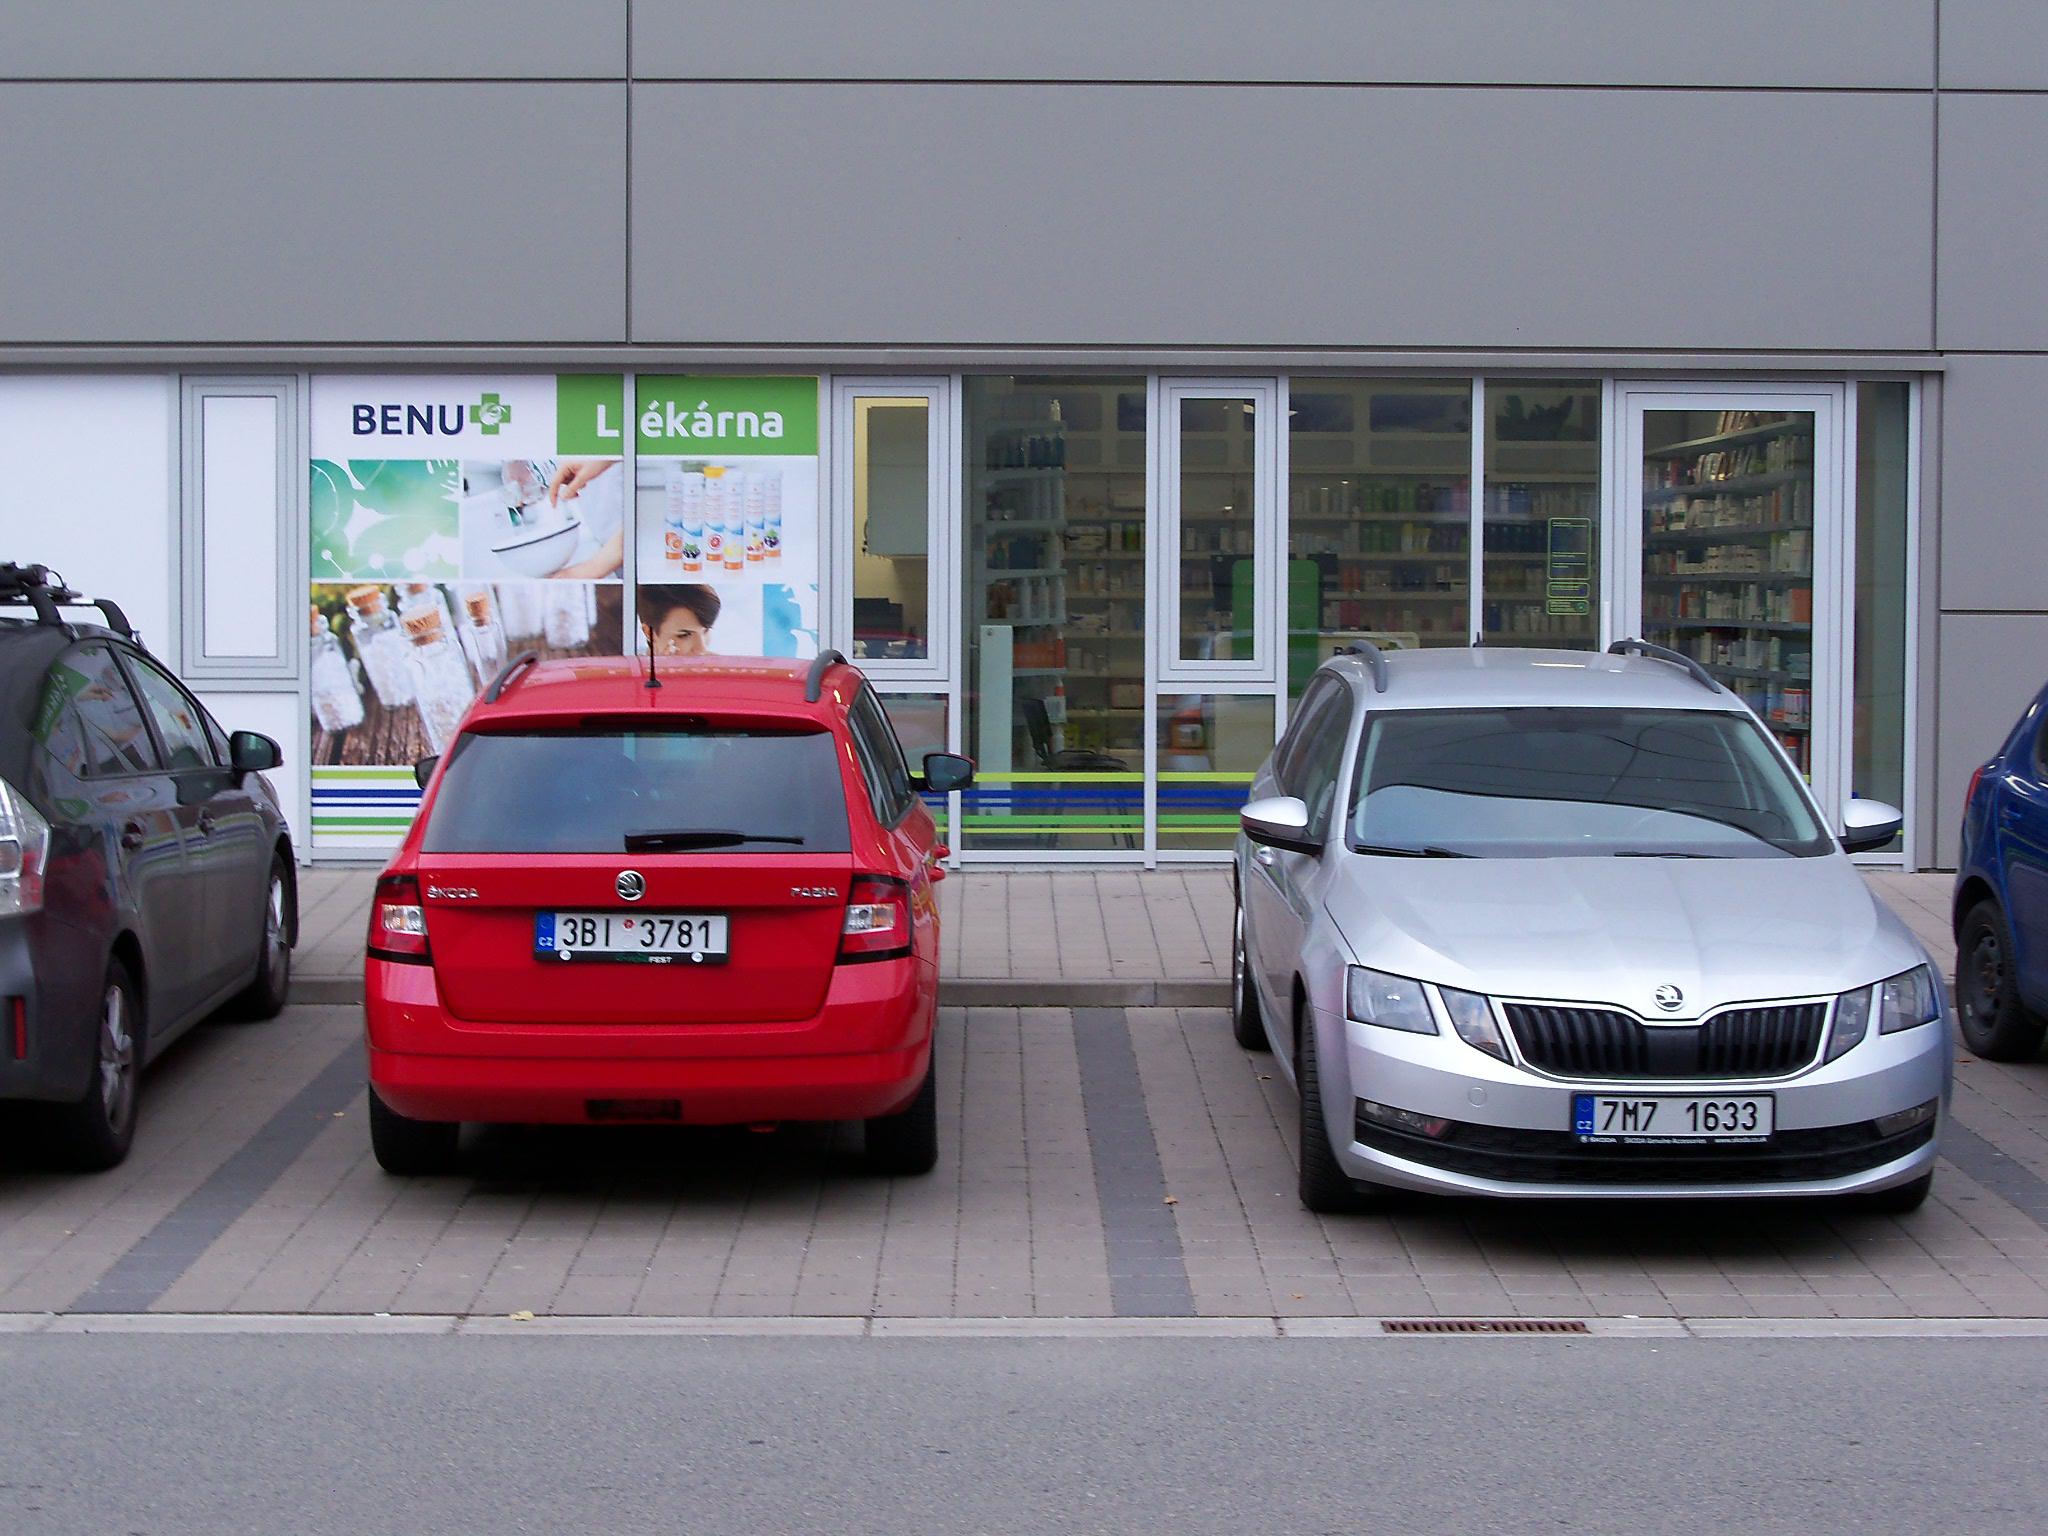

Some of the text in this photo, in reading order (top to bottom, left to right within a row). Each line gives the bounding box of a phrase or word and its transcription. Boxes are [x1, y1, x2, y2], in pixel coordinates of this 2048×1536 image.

[352, 404, 465, 436] BENU
[538, 936, 553, 947] CZ
[562, 918, 711, 949] 3BI 3781
[1576, 1120, 1592, 1130] CZ
[1602, 1101, 1758, 1131] 7M7 1633
